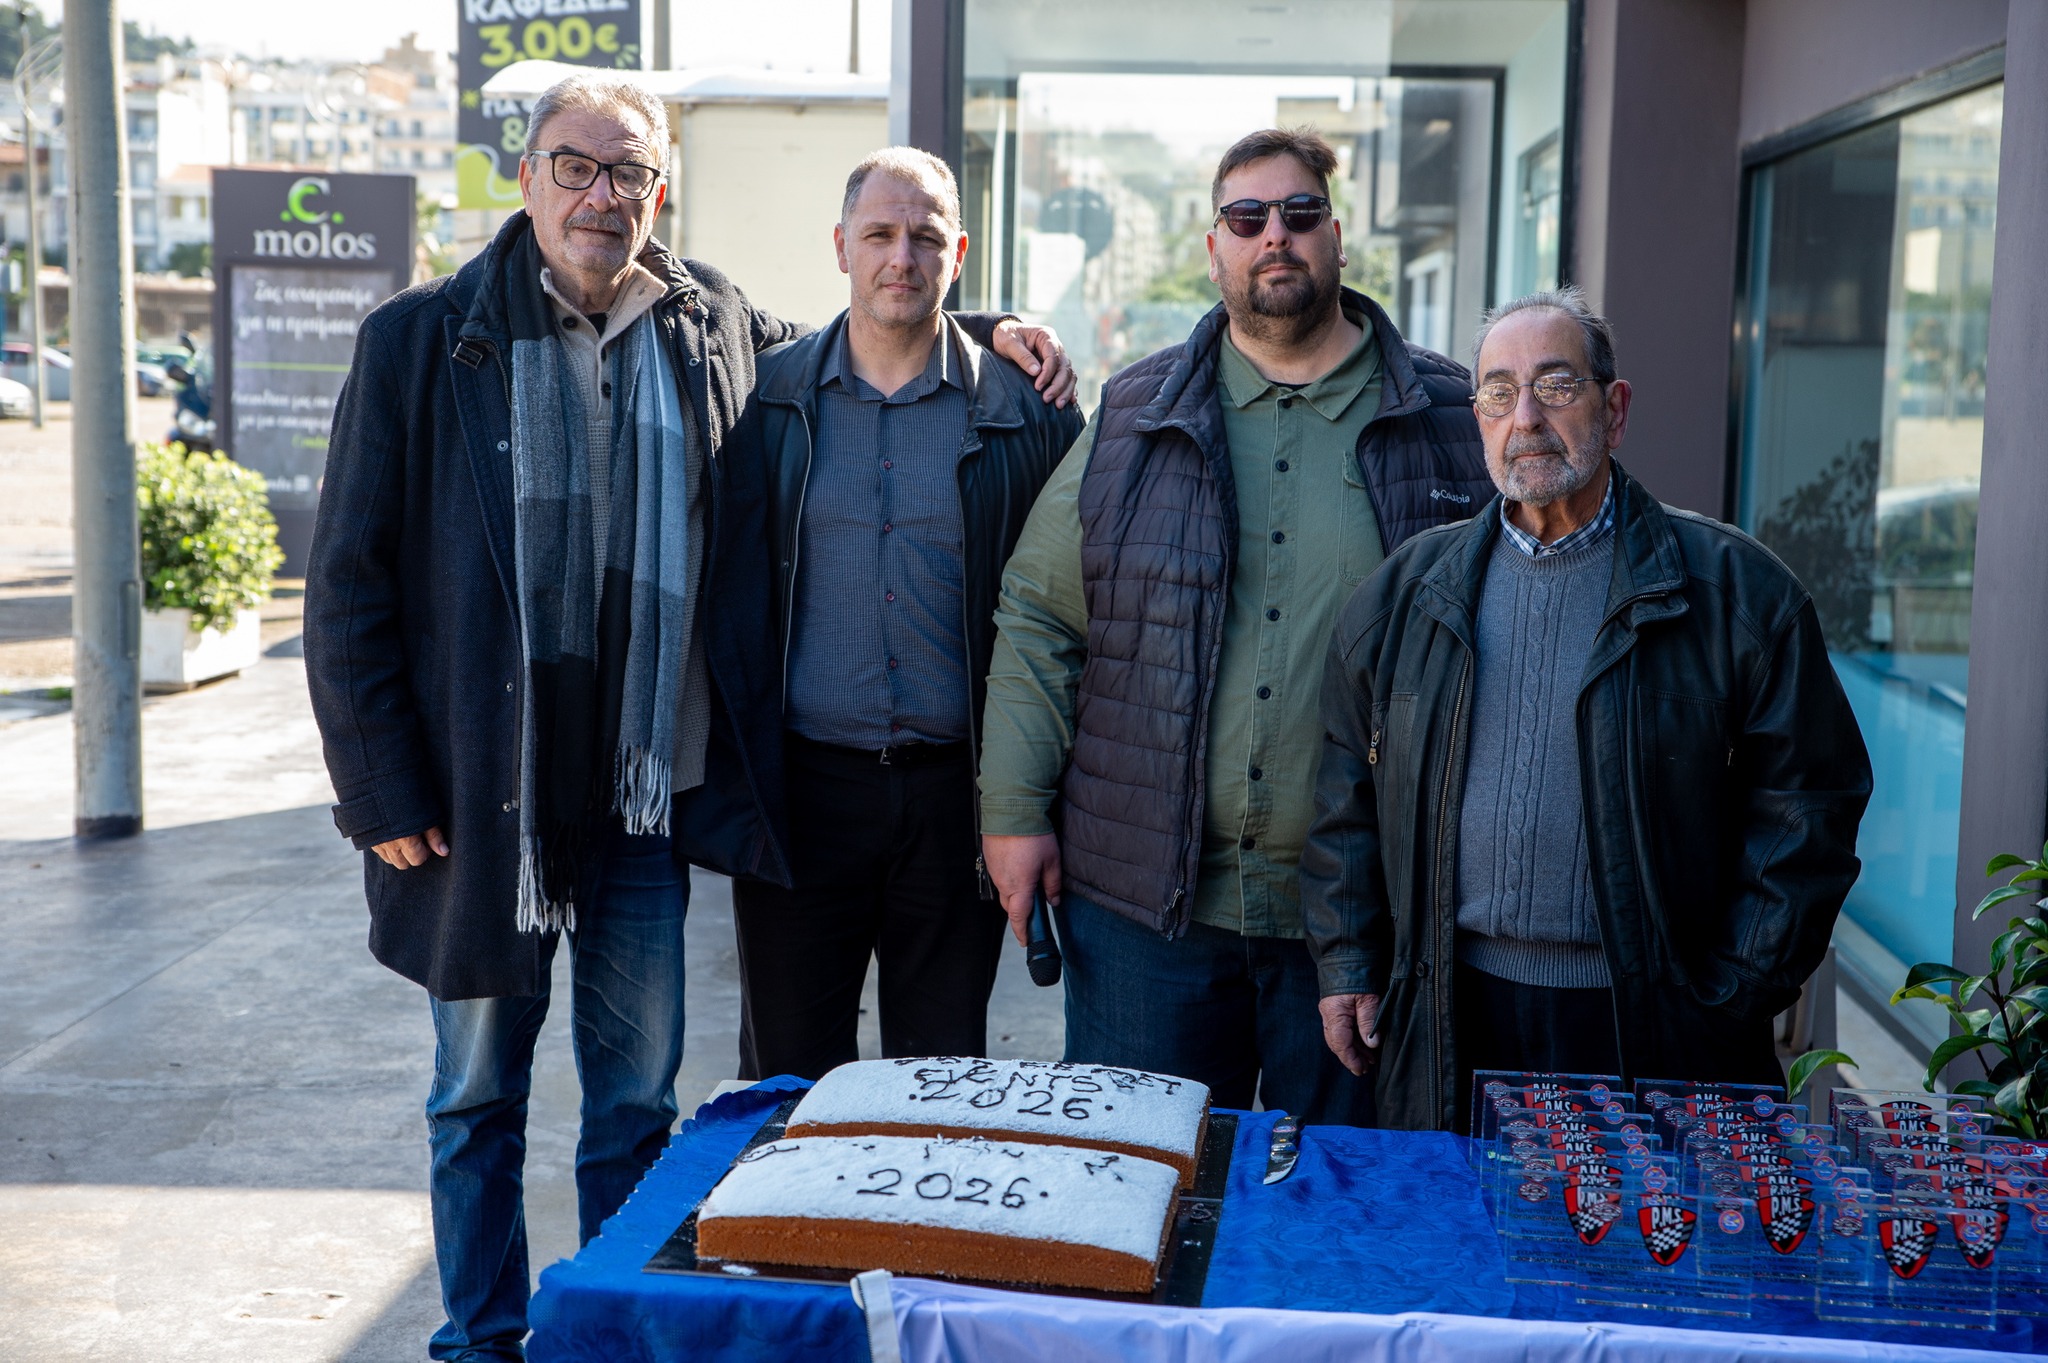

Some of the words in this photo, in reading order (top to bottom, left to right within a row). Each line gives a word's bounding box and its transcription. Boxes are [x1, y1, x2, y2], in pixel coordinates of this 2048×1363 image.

[479, 16, 619, 67] 3.00€
[253, 223, 376, 260] molos
[1652, 1207, 1684, 1229] P.M.S.
[1771, 1196, 1803, 1219] P.M.S.
[1892, 1219, 1926, 1243] P.M.S.
